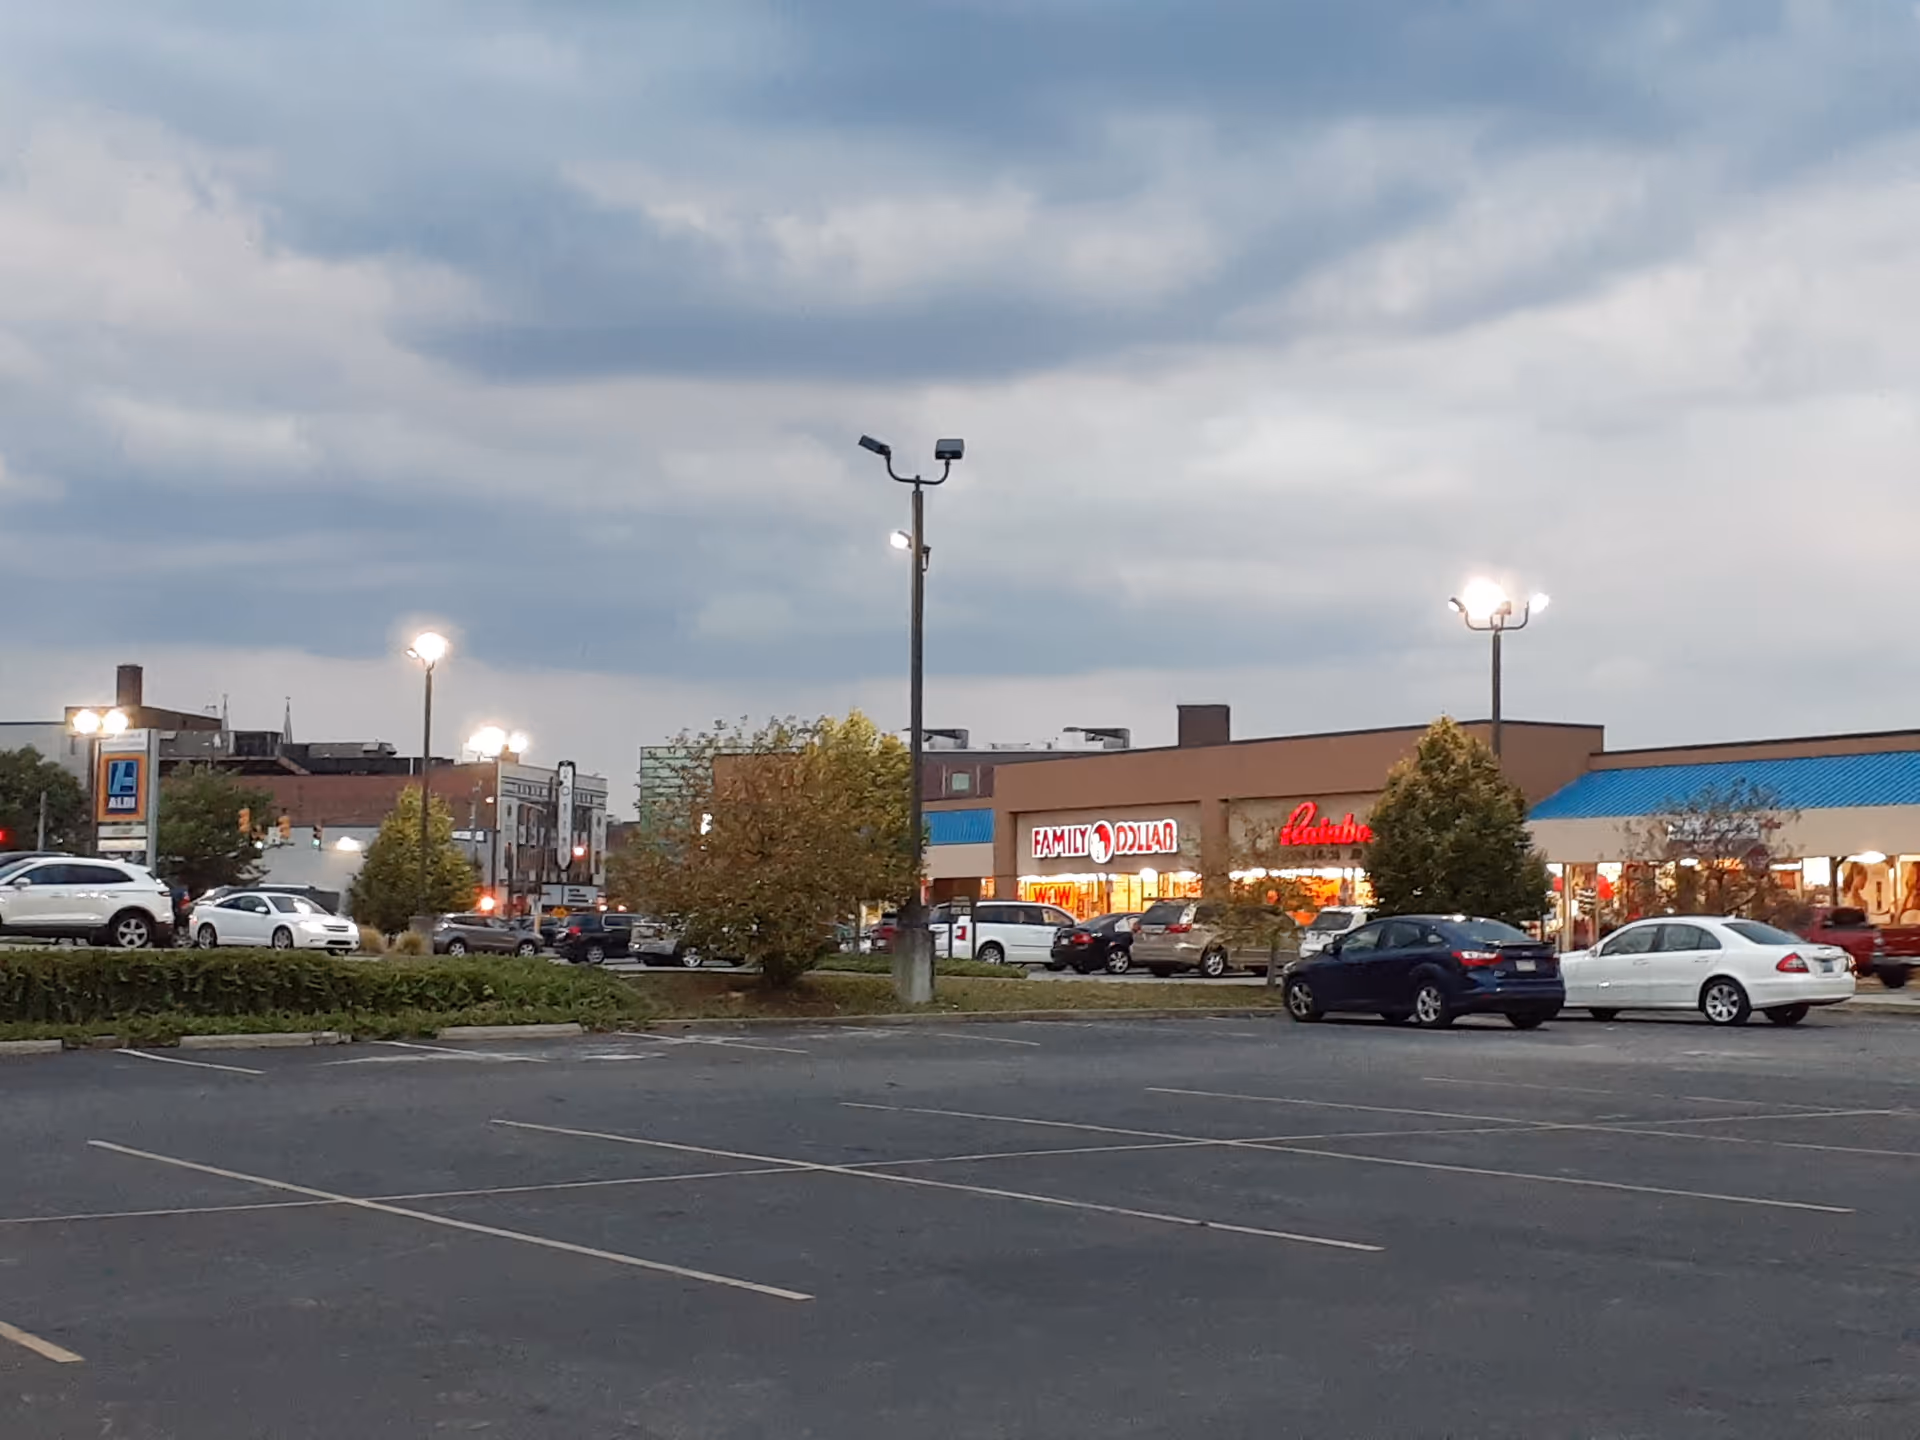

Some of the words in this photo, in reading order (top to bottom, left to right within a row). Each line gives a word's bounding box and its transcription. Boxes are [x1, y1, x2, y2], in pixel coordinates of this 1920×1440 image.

[109, 797, 137, 809] ALDI
[1032, 825, 1092, 857] FAMILY
[1114, 819, 1179, 854] DOLLAR
[1280, 801, 1374, 846] Rainbo
